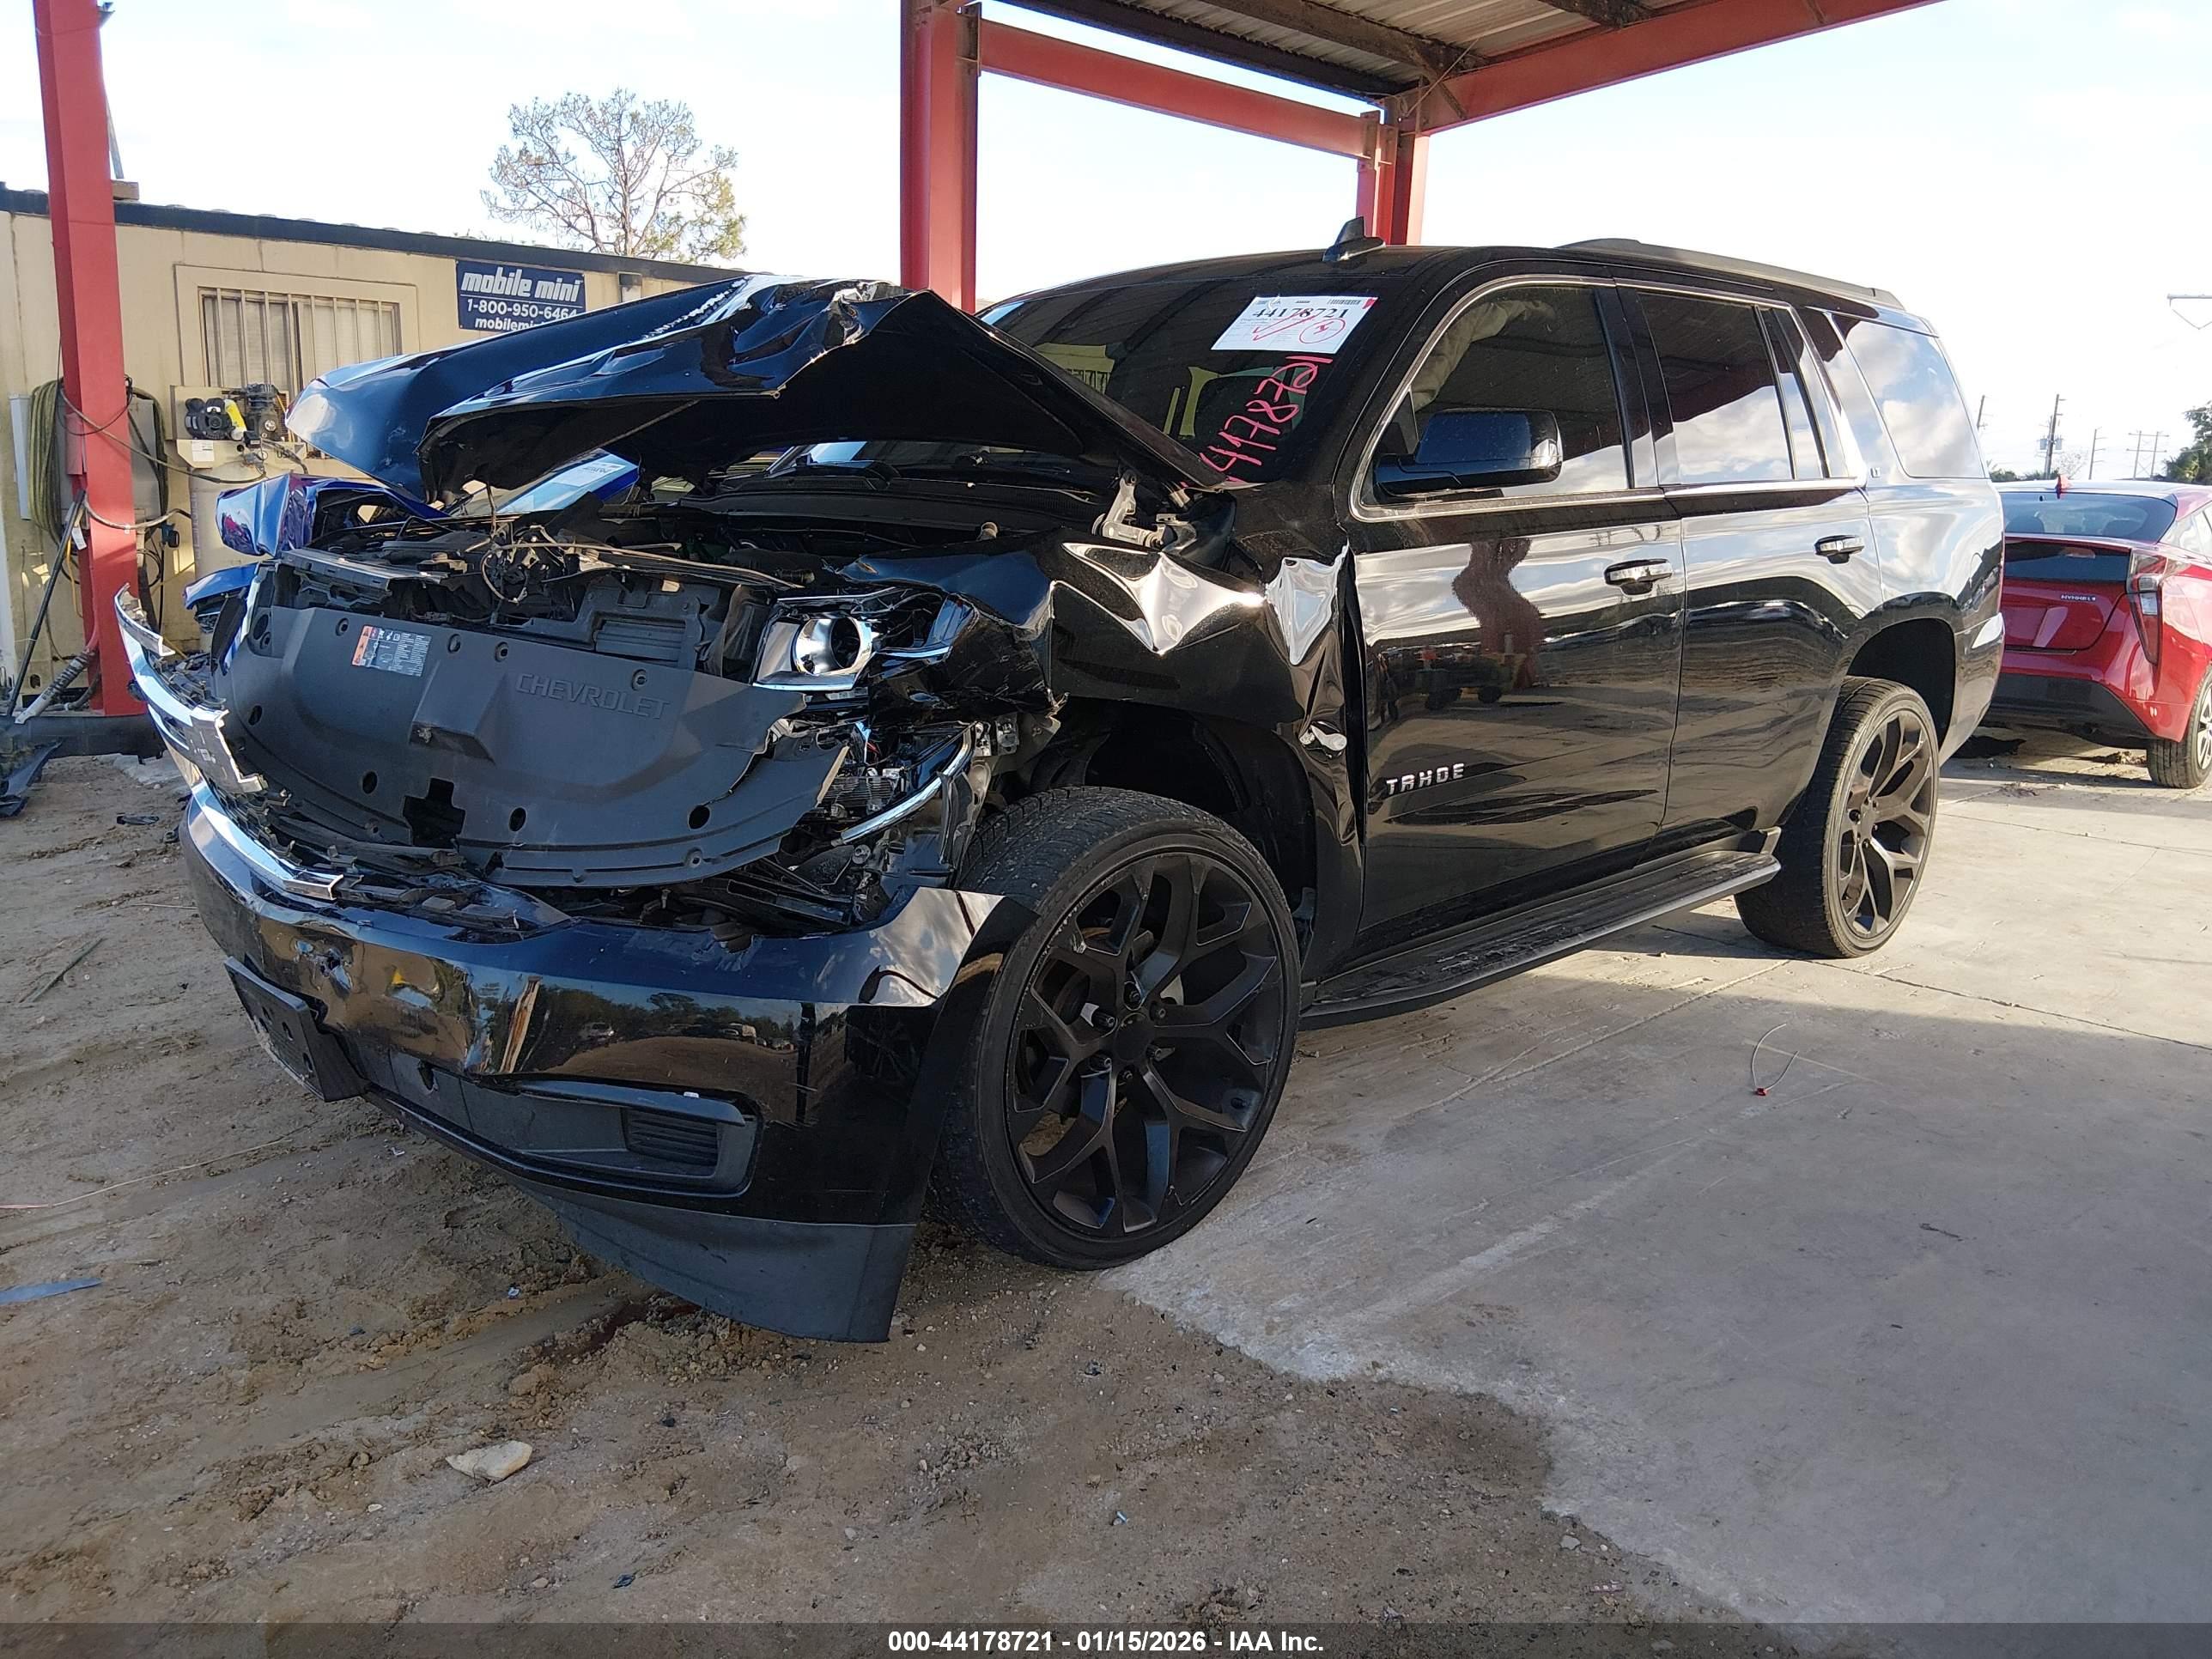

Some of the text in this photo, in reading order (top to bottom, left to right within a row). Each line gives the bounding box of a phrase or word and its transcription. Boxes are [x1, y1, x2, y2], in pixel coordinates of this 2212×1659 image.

[461, 267, 581, 302] mobile mini
[467, 298, 577, 320] 1-800-950-6464
[1253, 307, 1349, 319] 44178721
[515, 673, 672, 720] CHEVROLET
[1386, 763, 1465, 795] TAHOE
